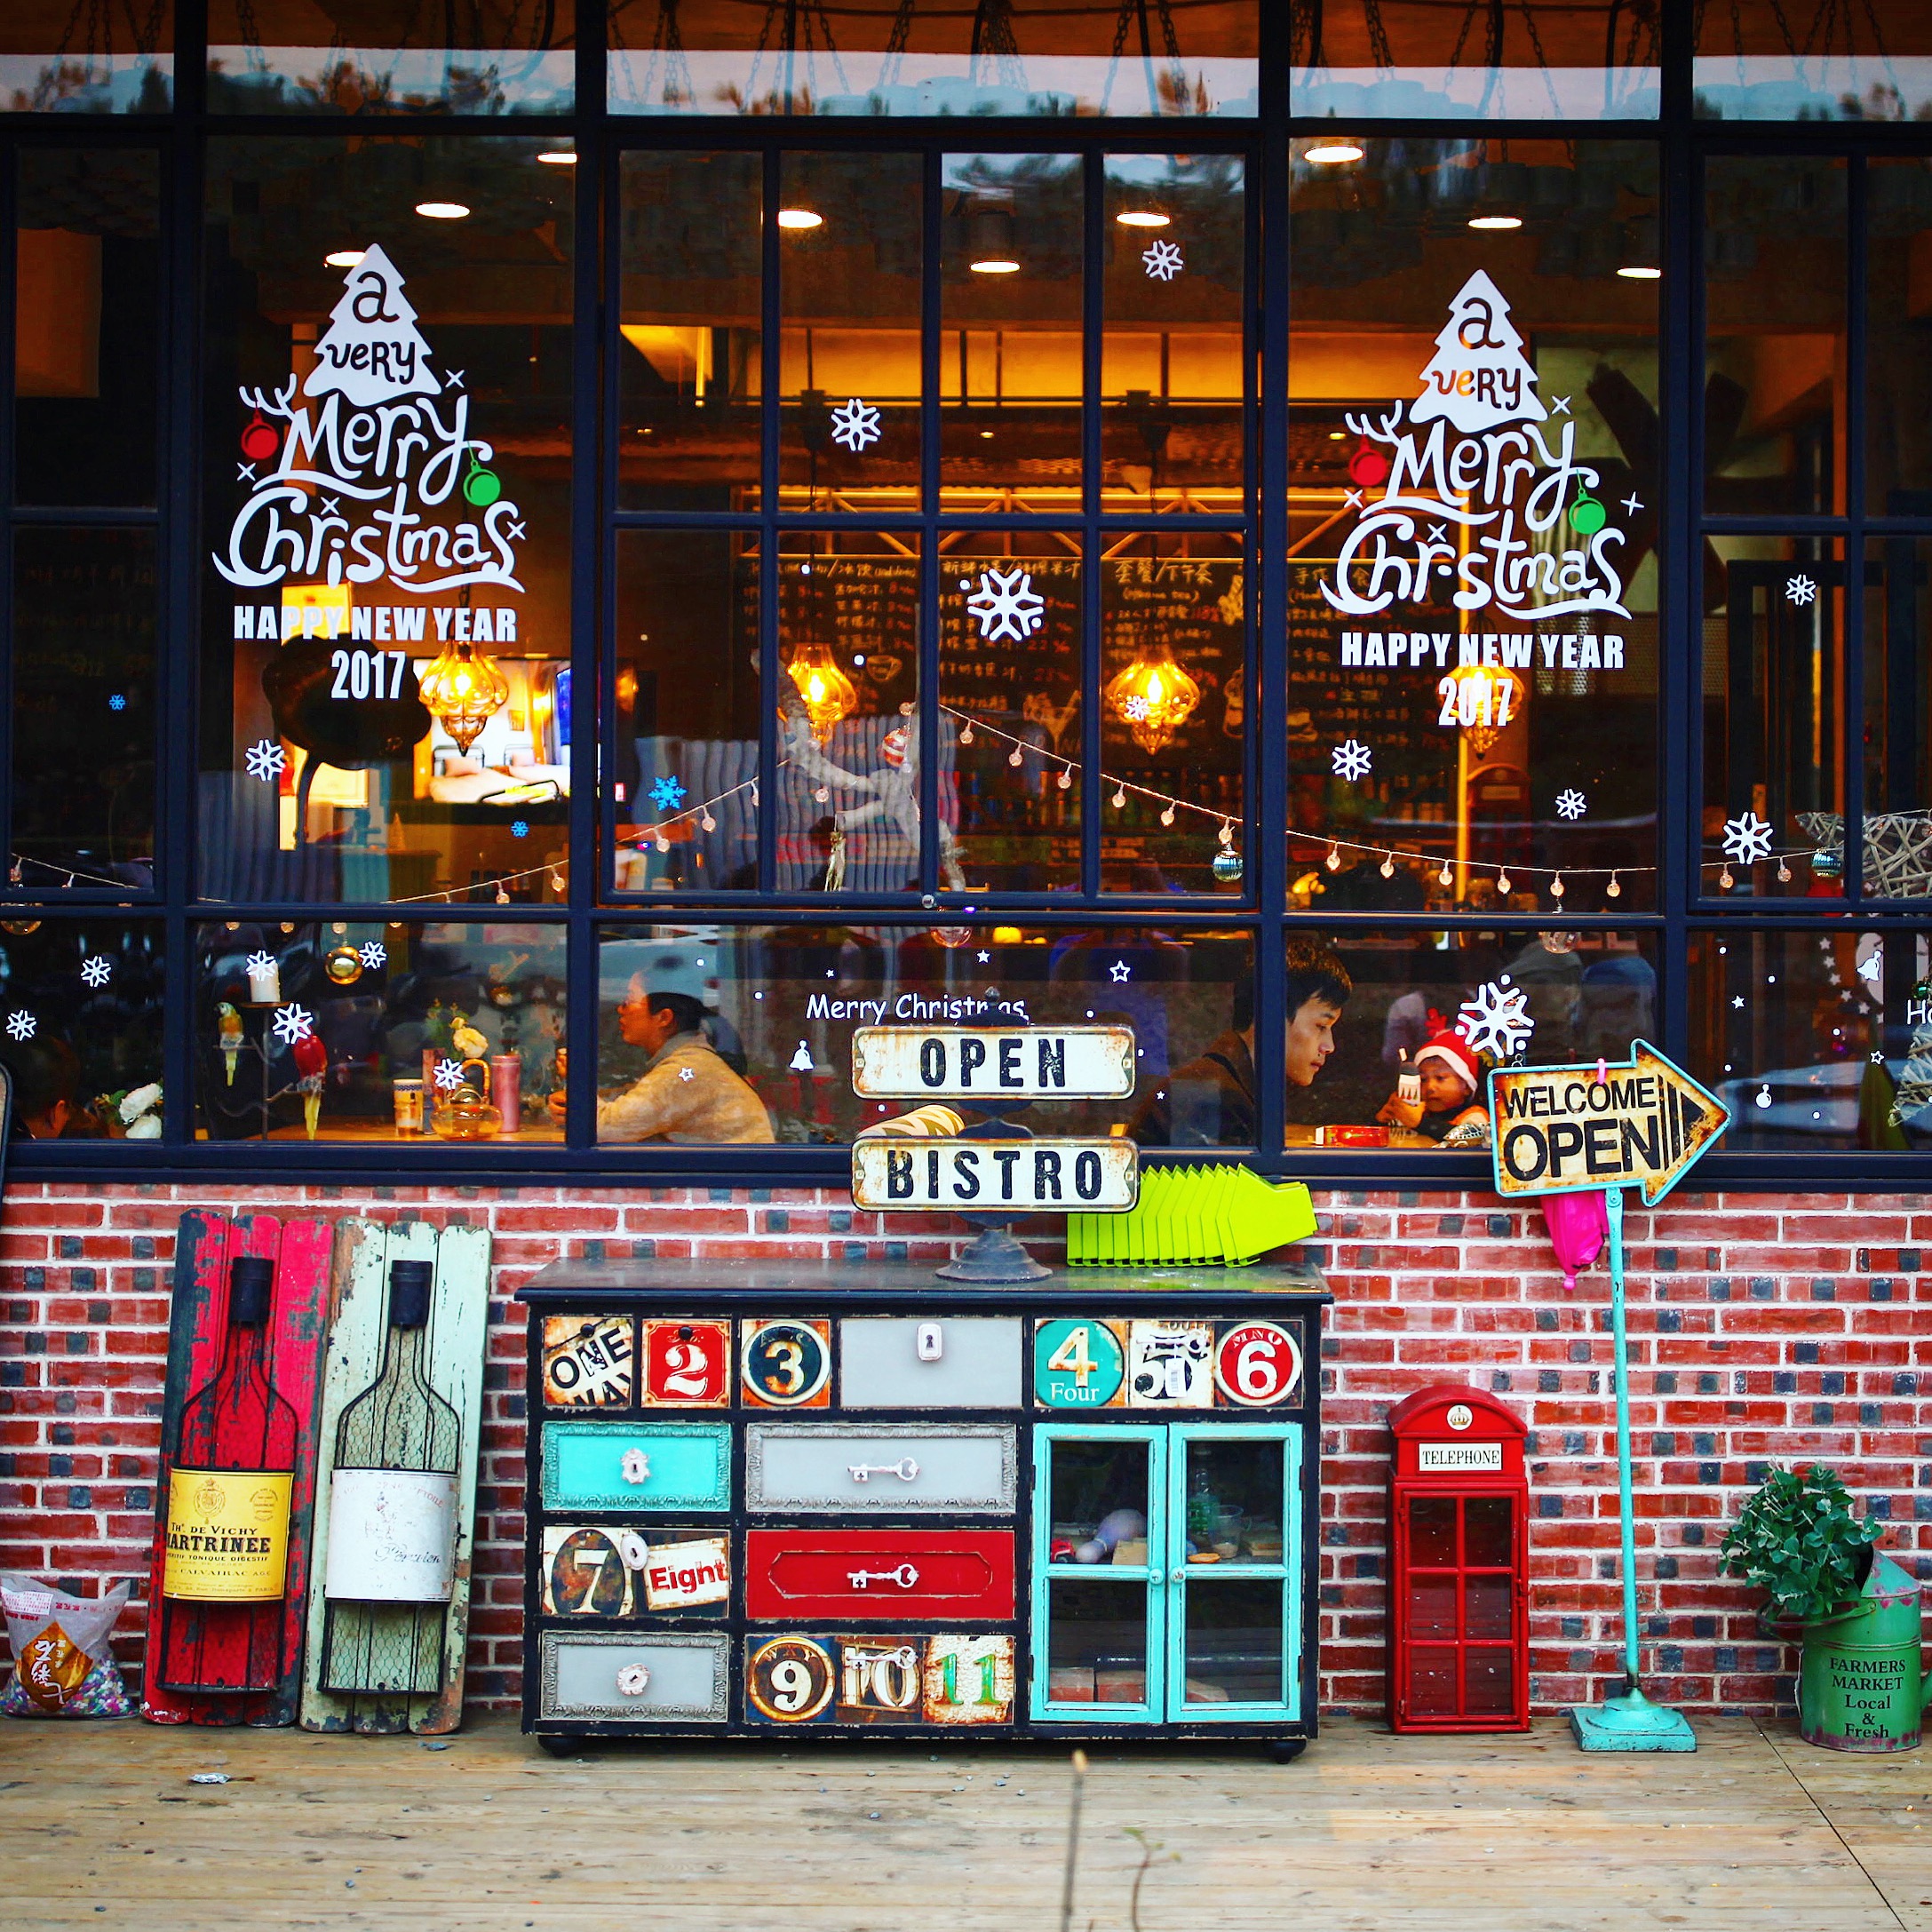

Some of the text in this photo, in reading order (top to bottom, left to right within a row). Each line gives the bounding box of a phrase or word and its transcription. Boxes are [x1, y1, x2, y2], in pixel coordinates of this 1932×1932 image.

[352, 271, 399, 323] a
[1458, 297, 1506, 349] a
[251, 392, 493, 505] Merry
[1358, 420, 1599, 531] Merry
[212, 482, 525, 592] Christmas
[234, 606, 517, 641] HAPPY NEW YEAR
[331, 650, 406, 699] 2017
[1341, 632, 1451, 666] HAPPY
[1459, 633, 1533, 667] NEW
[1541, 635, 1625, 669] YEAR
[1438, 678, 1514, 727] 2017
[807, 994, 886, 1025] Merry
[919, 1038, 1066, 1088] OPEN
[1502, 1077, 1657, 1119] WELCOME
[1503, 1115, 1661, 1181] OPEN
[887, 1150, 1102, 1200] BISTRO
[551, 1326, 632, 1389] ONE
[664, 1344, 708, 1398] 2
[764, 1340, 805, 1395] 3
[1048, 1327, 1099, 1387] 4
[1236, 1340, 1277, 1397] 6
[1050, 1383, 1100, 1403] Four
[1422, 1451, 1499, 1465] TELEPHONE
[211, 1525, 258, 1536] VICHY
[570, 1548, 609, 1614] 7
[649, 1560, 728, 1594] Eight
[771, 1659, 813, 1713] 9
[844, 1646, 920, 1707] 10
[933, 1652, 1001, 1705] 11
[1830, 1658, 1905, 1674] FARMERS
[1833, 1675, 1904, 1690] MARKET
[1845, 1695, 1891, 1709] Local
[1862, 1713, 1875, 1725] &
[1845, 1722, 1889, 1738] Fresh
